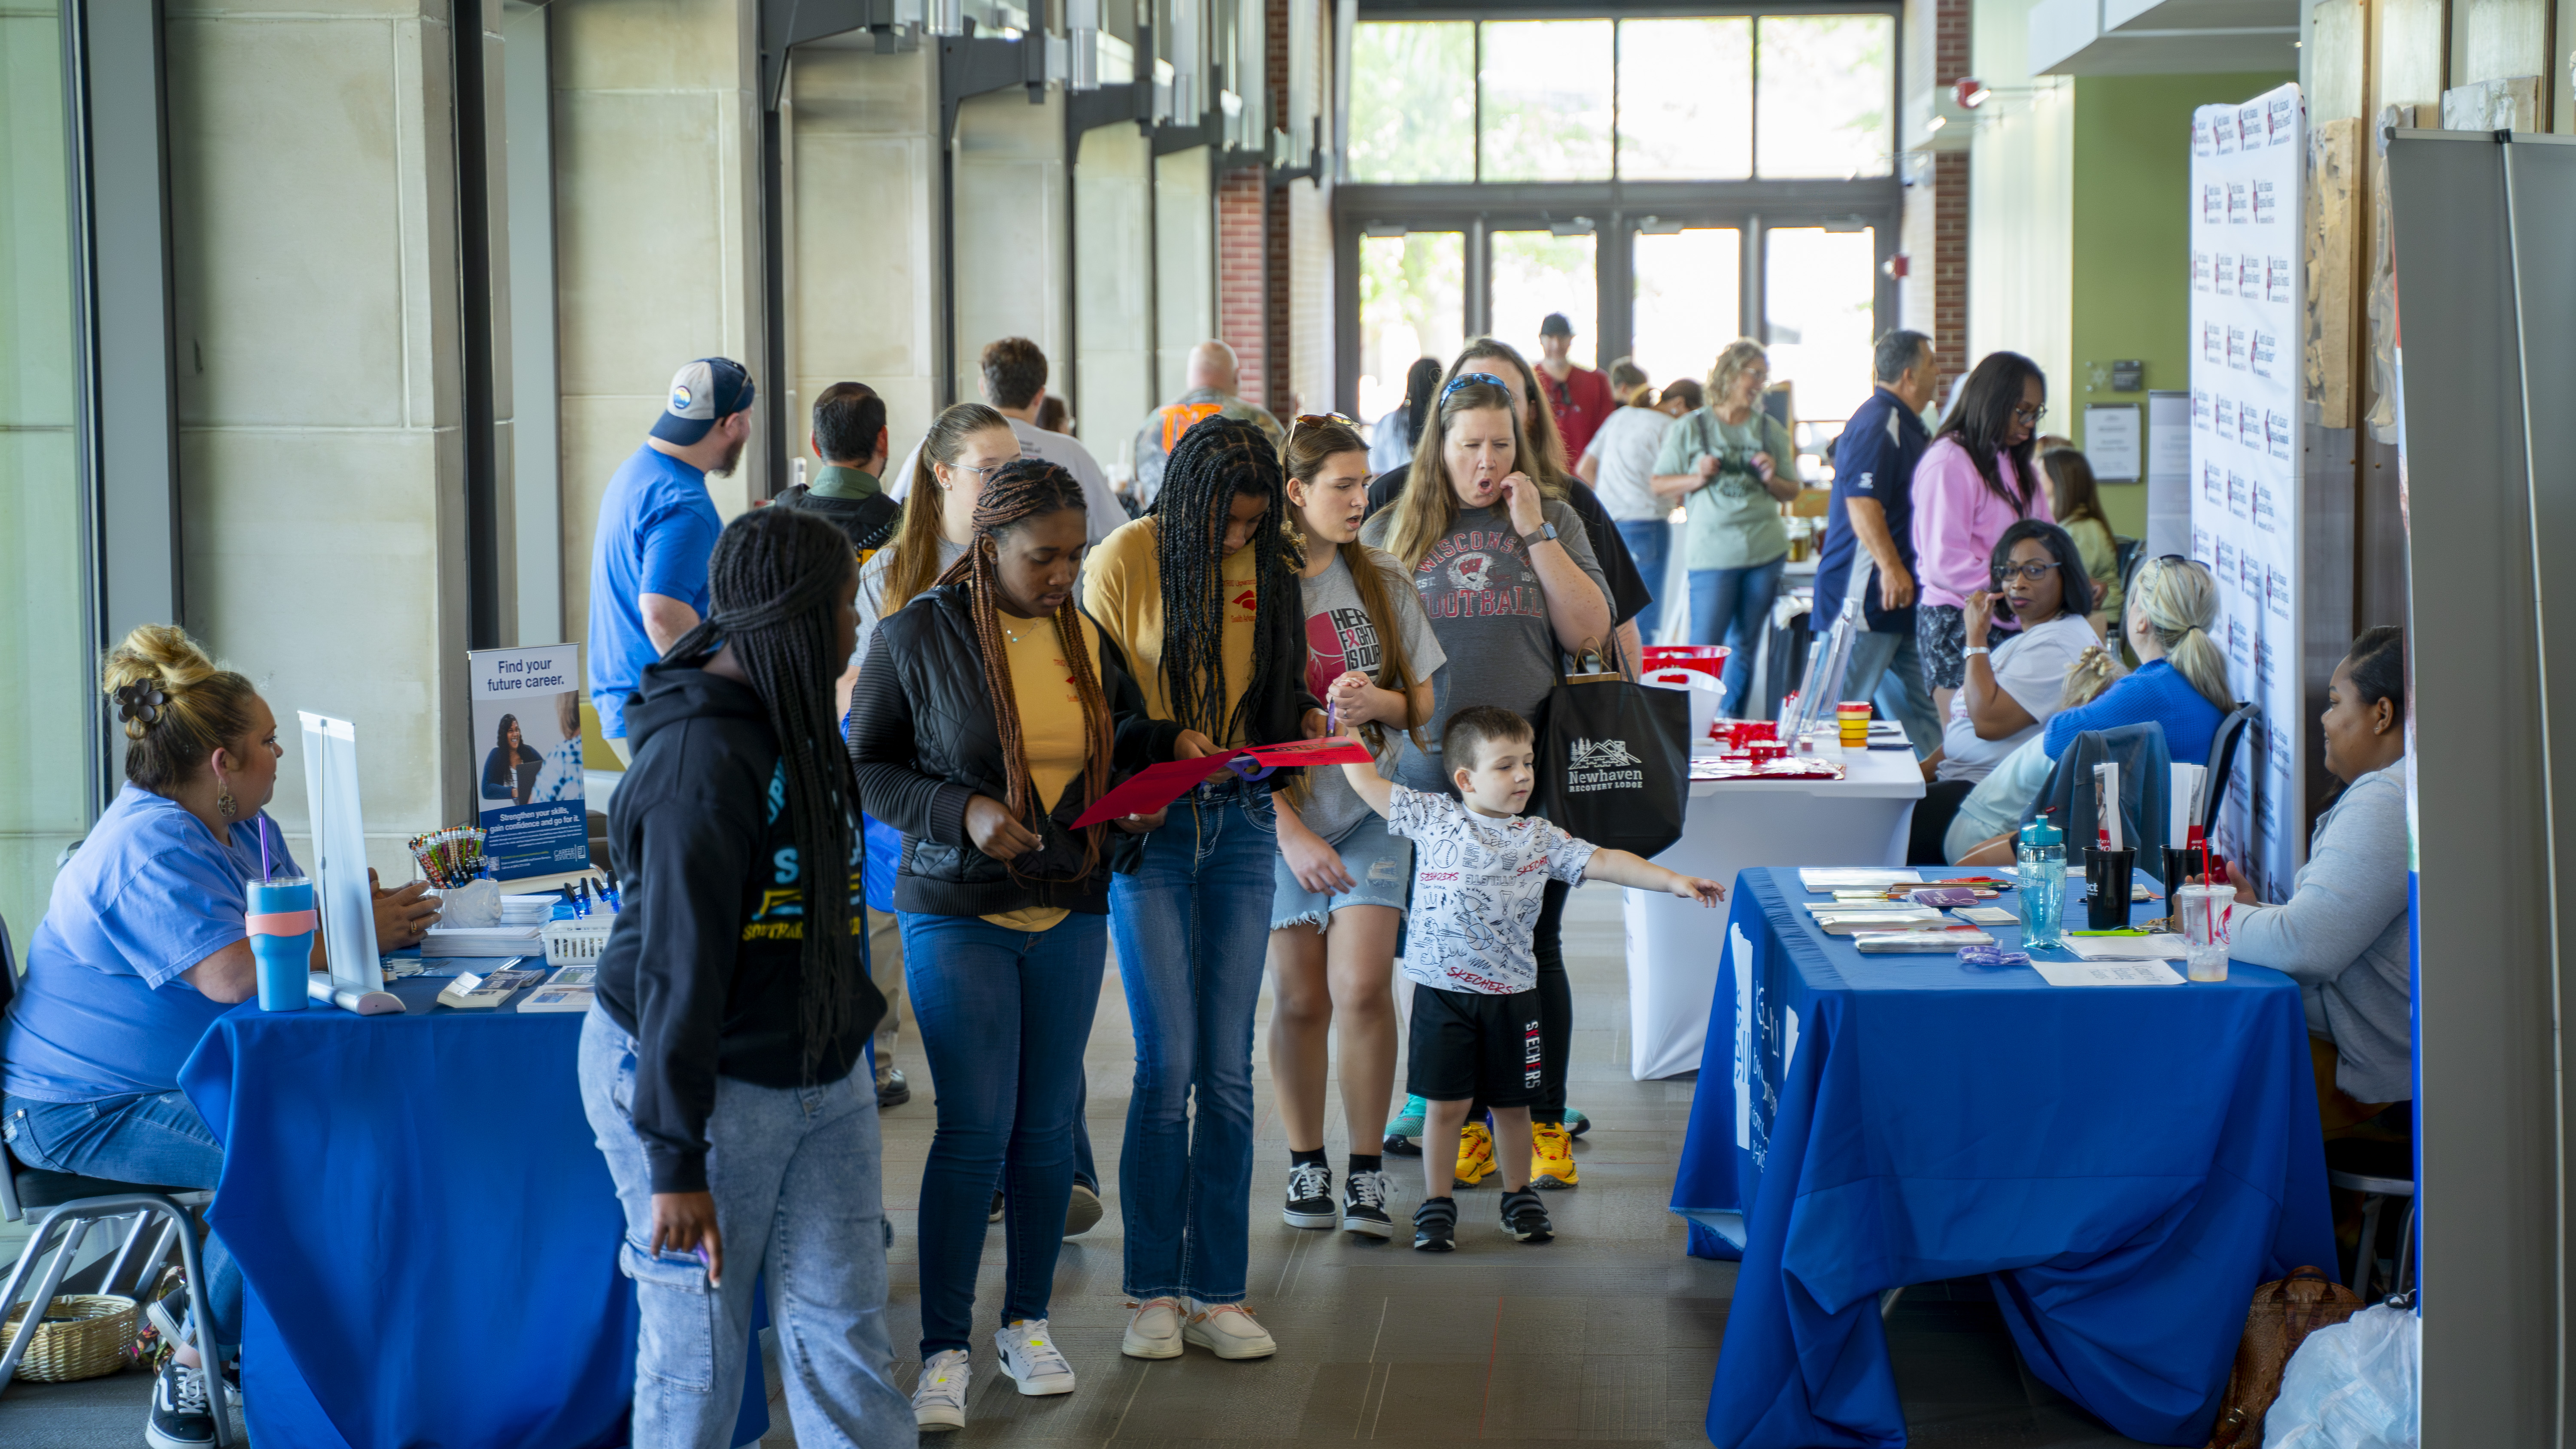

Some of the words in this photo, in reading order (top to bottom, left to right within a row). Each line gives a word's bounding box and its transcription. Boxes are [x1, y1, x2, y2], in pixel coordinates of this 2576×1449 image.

[1415, 531, 1531, 573] WISCONSIN
[1330, 608, 1373, 630] HER
[1346, 649, 1358, 670] IS
[1359, 645, 1381, 667] OUR
[498, 660, 523, 674] Find
[526, 659, 552, 674] your
[487, 678, 522, 691] future
[525, 674, 565, 688] career.
[1568, 769, 1643, 784] Newhaven
[1569, 782, 1613, 792] RECOVERY
[500, 811, 535, 822] Strengthen
[535, 810, 550, 818] your
[550, 807, 569, 816] skills,
[489, 825, 504, 834] gain
[505, 821, 540, 831] confidence
[1482, 838, 1512, 849] KEEP
[1462, 843, 1480, 869] PLAY
[1517, 855, 1549, 876] SKECH
[1420, 872, 1460, 882] SKECHERS
[1465, 873, 1517, 886] ATHLETE
[2086, 883, 2099, 892] ect
[1447, 967, 1513, 994] SKECHERS
[1525, 1021, 1541, 1089] SKECHERS
